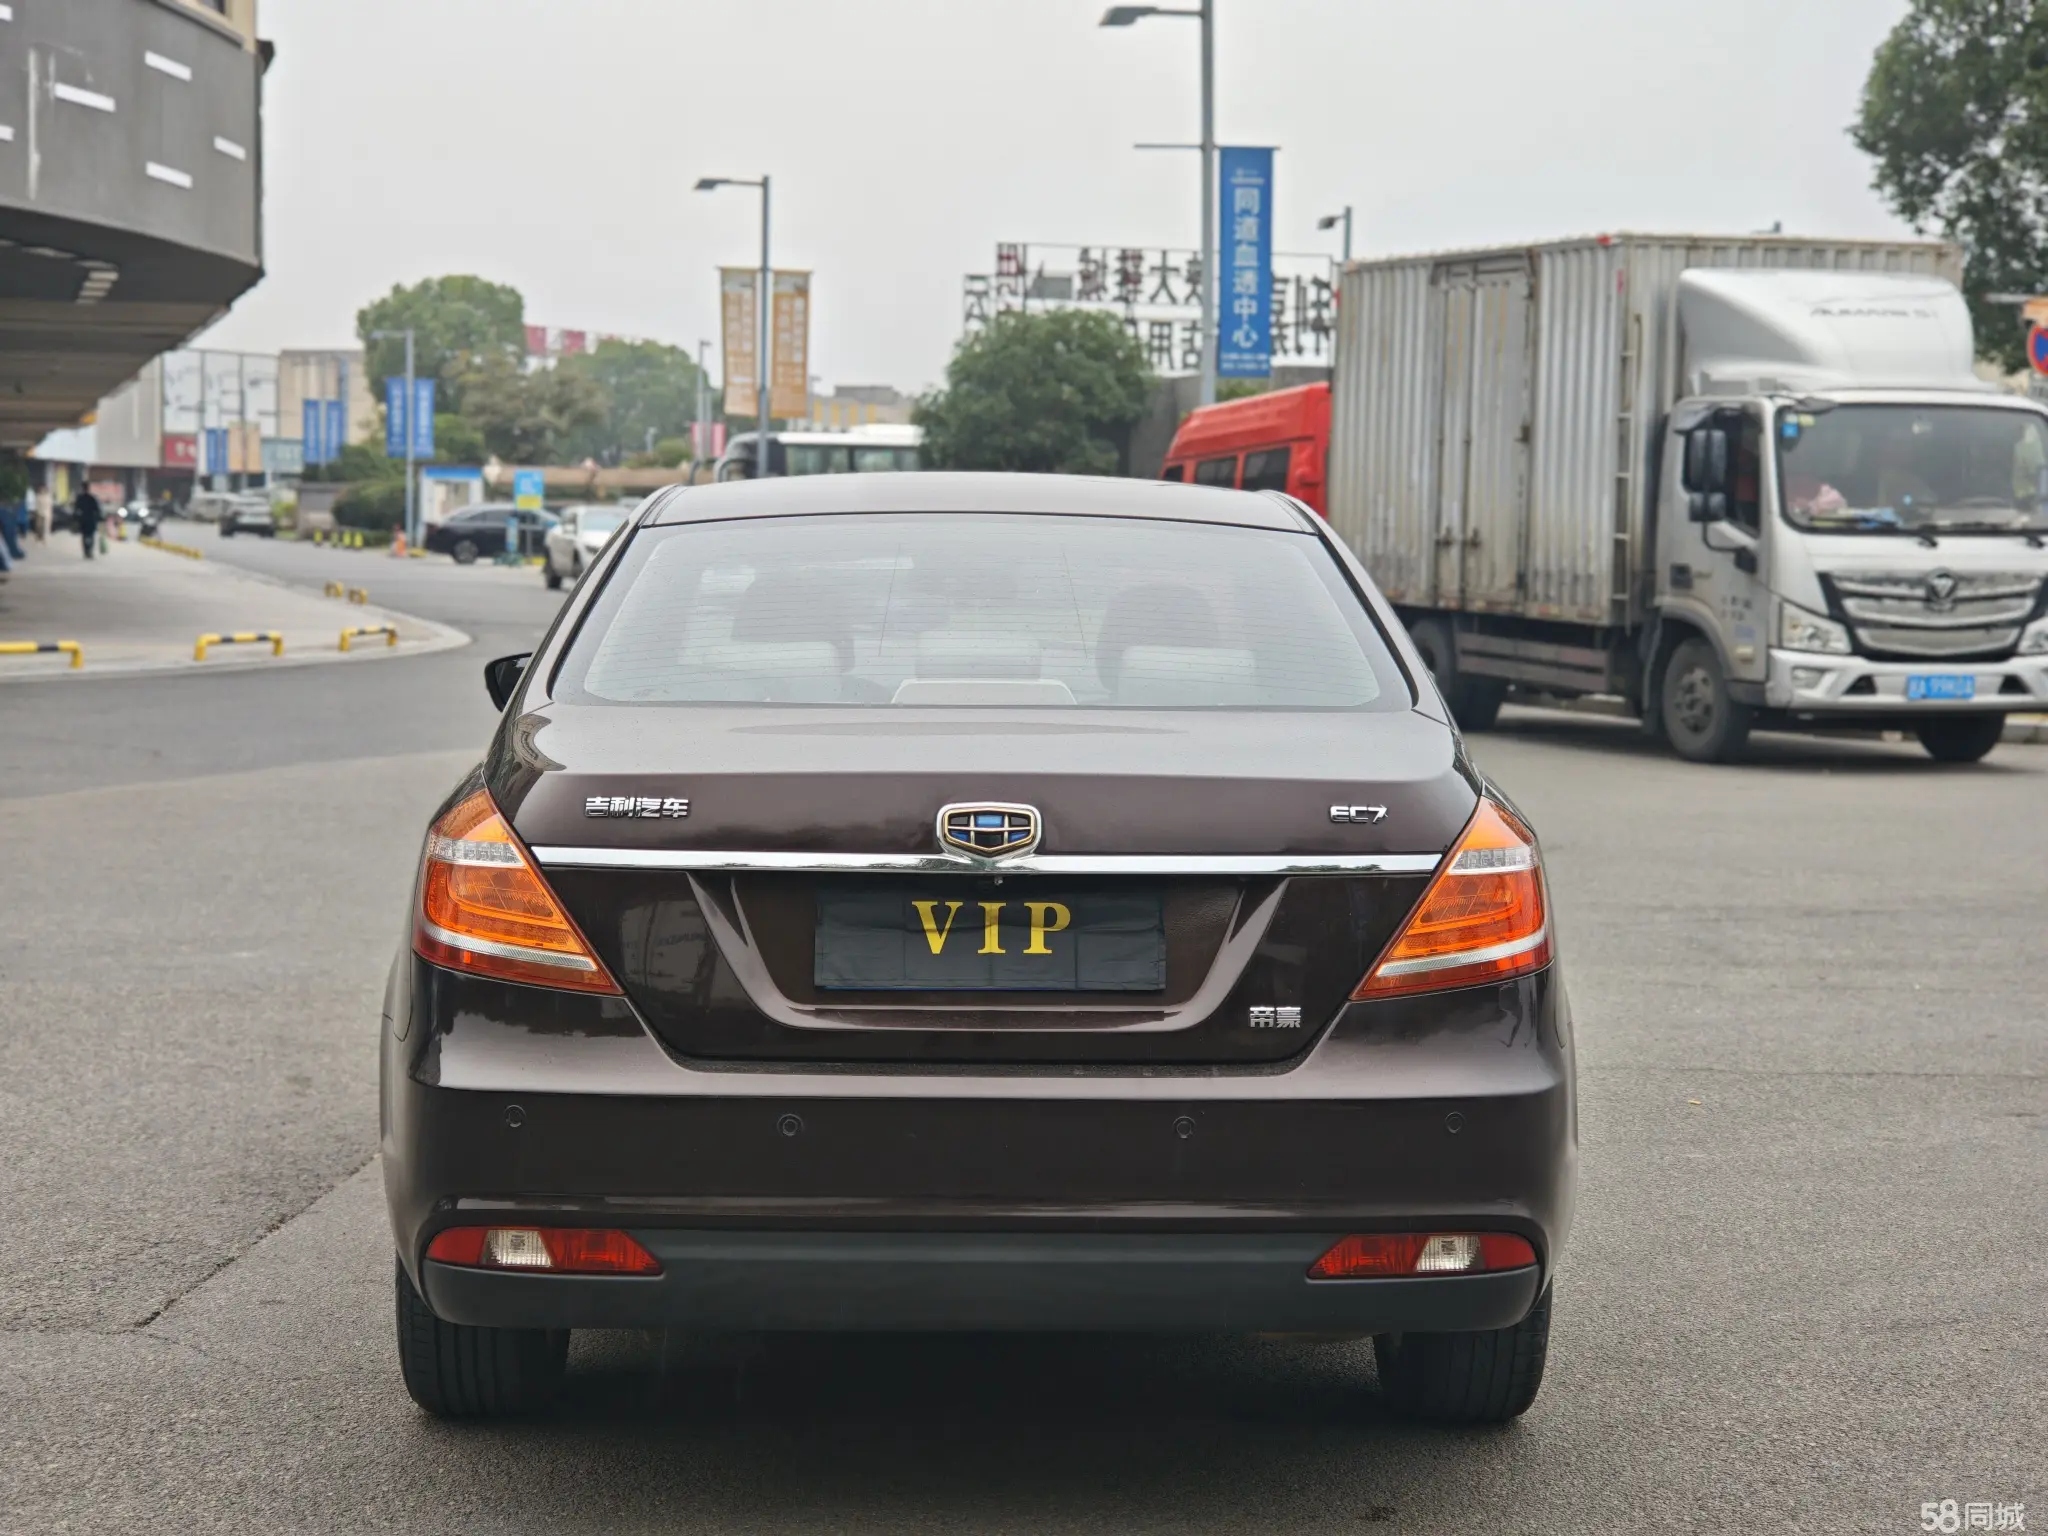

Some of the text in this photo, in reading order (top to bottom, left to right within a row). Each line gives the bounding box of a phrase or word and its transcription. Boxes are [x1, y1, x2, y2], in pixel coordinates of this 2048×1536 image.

[585, 796, 689, 818] 吉利汽车
[1329, 804, 1388, 823] EC7
[912, 900, 1071, 954] VIP
[1249, 1006, 1302, 1028] 帝豪
